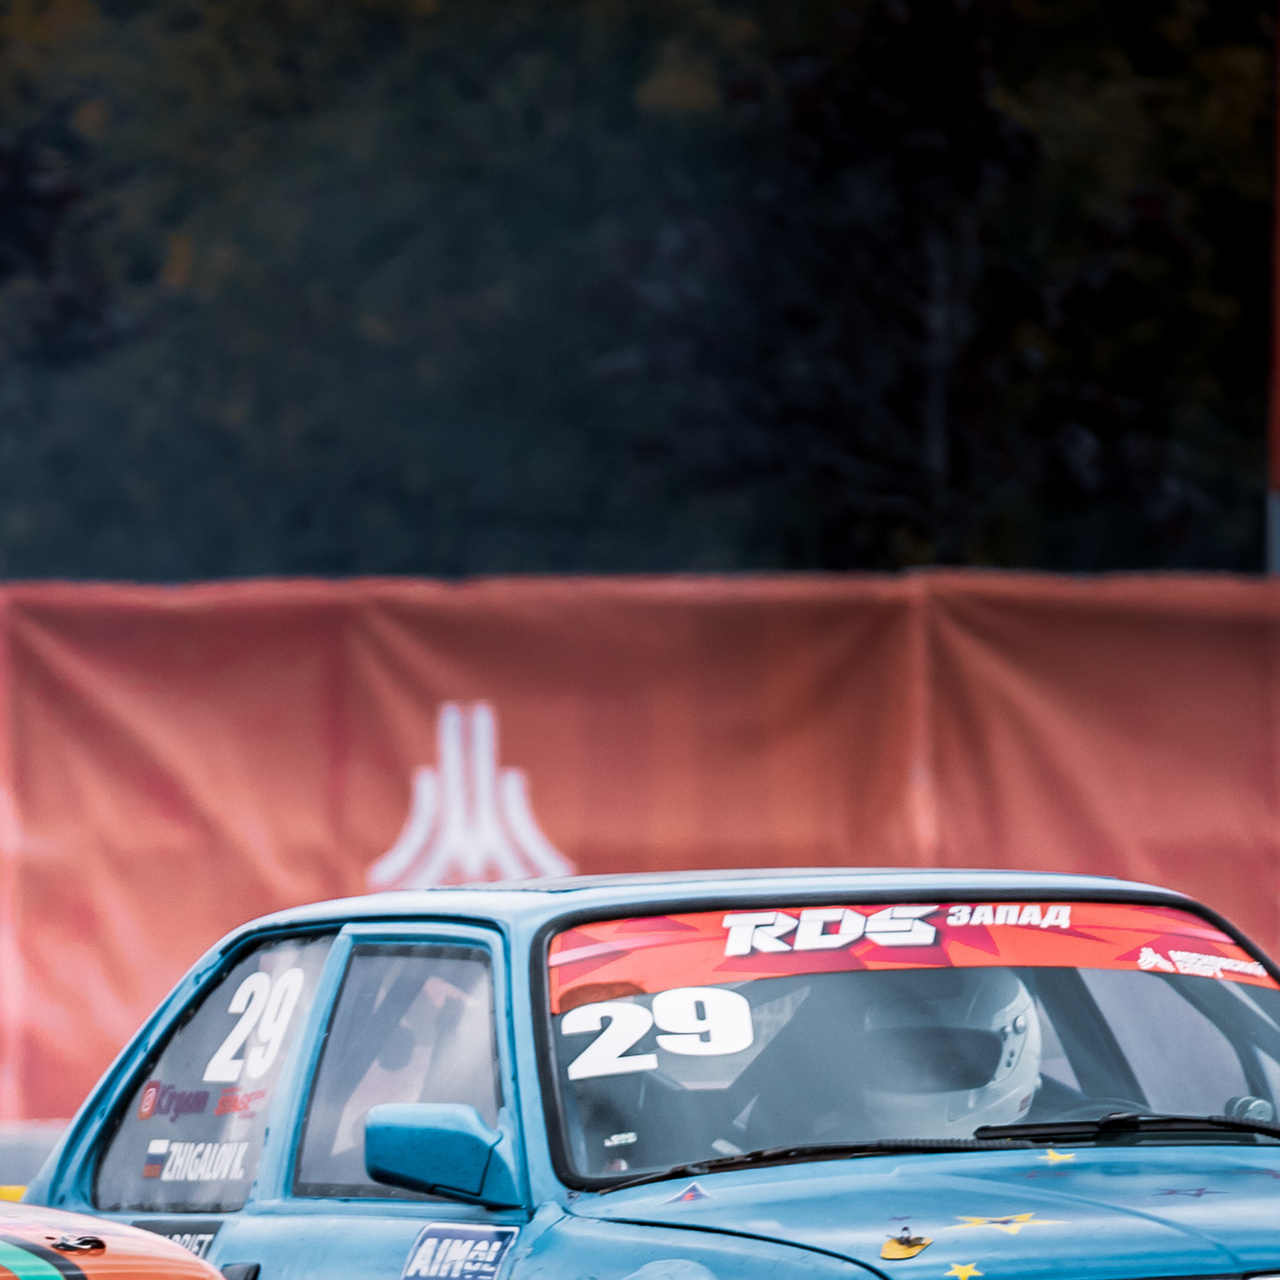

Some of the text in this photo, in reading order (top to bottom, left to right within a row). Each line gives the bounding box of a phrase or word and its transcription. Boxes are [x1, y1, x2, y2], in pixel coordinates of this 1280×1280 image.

[722, 906, 939, 956] RDS
[946, 905, 1071, 929] ЗАПАД
[202, 967, 305, 1083] 29
[560, 986, 754, 1081] 29
[406, 1237, 503, 1280] AIMOL
